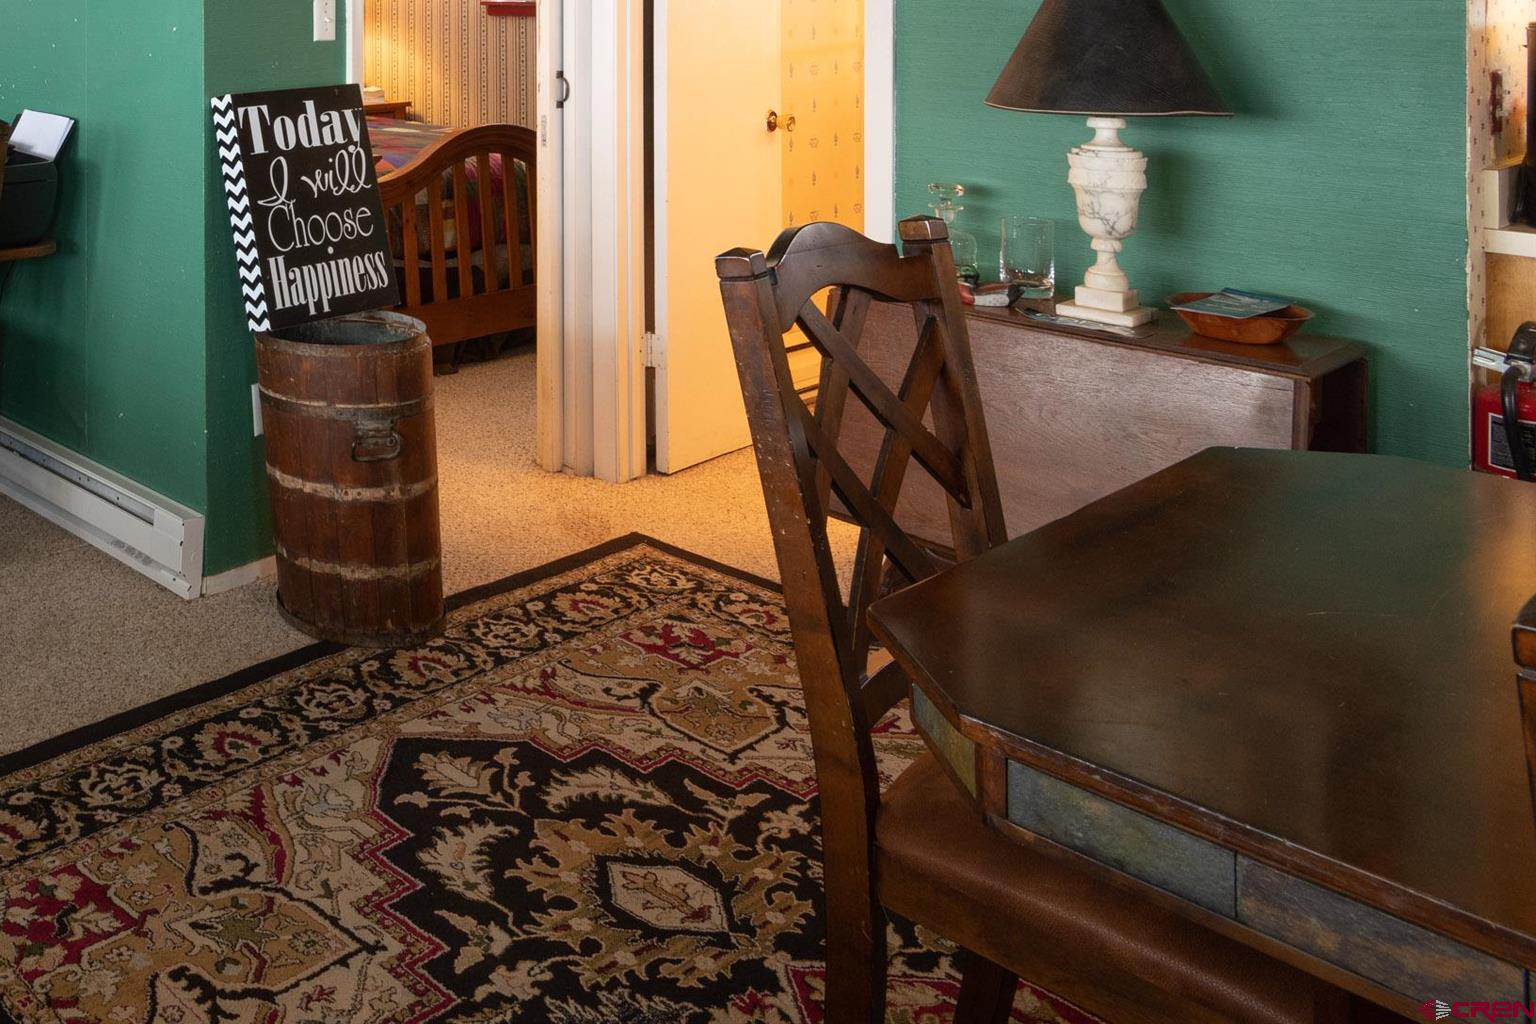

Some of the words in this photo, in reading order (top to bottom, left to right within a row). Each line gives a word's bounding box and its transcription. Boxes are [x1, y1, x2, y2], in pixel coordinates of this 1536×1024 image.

[237, 100, 363, 155] Today
[258, 156, 295, 207] I
[301, 147, 371, 199] will
[267, 200, 374, 252] Choose
[267, 246, 389, 316] Happiness
